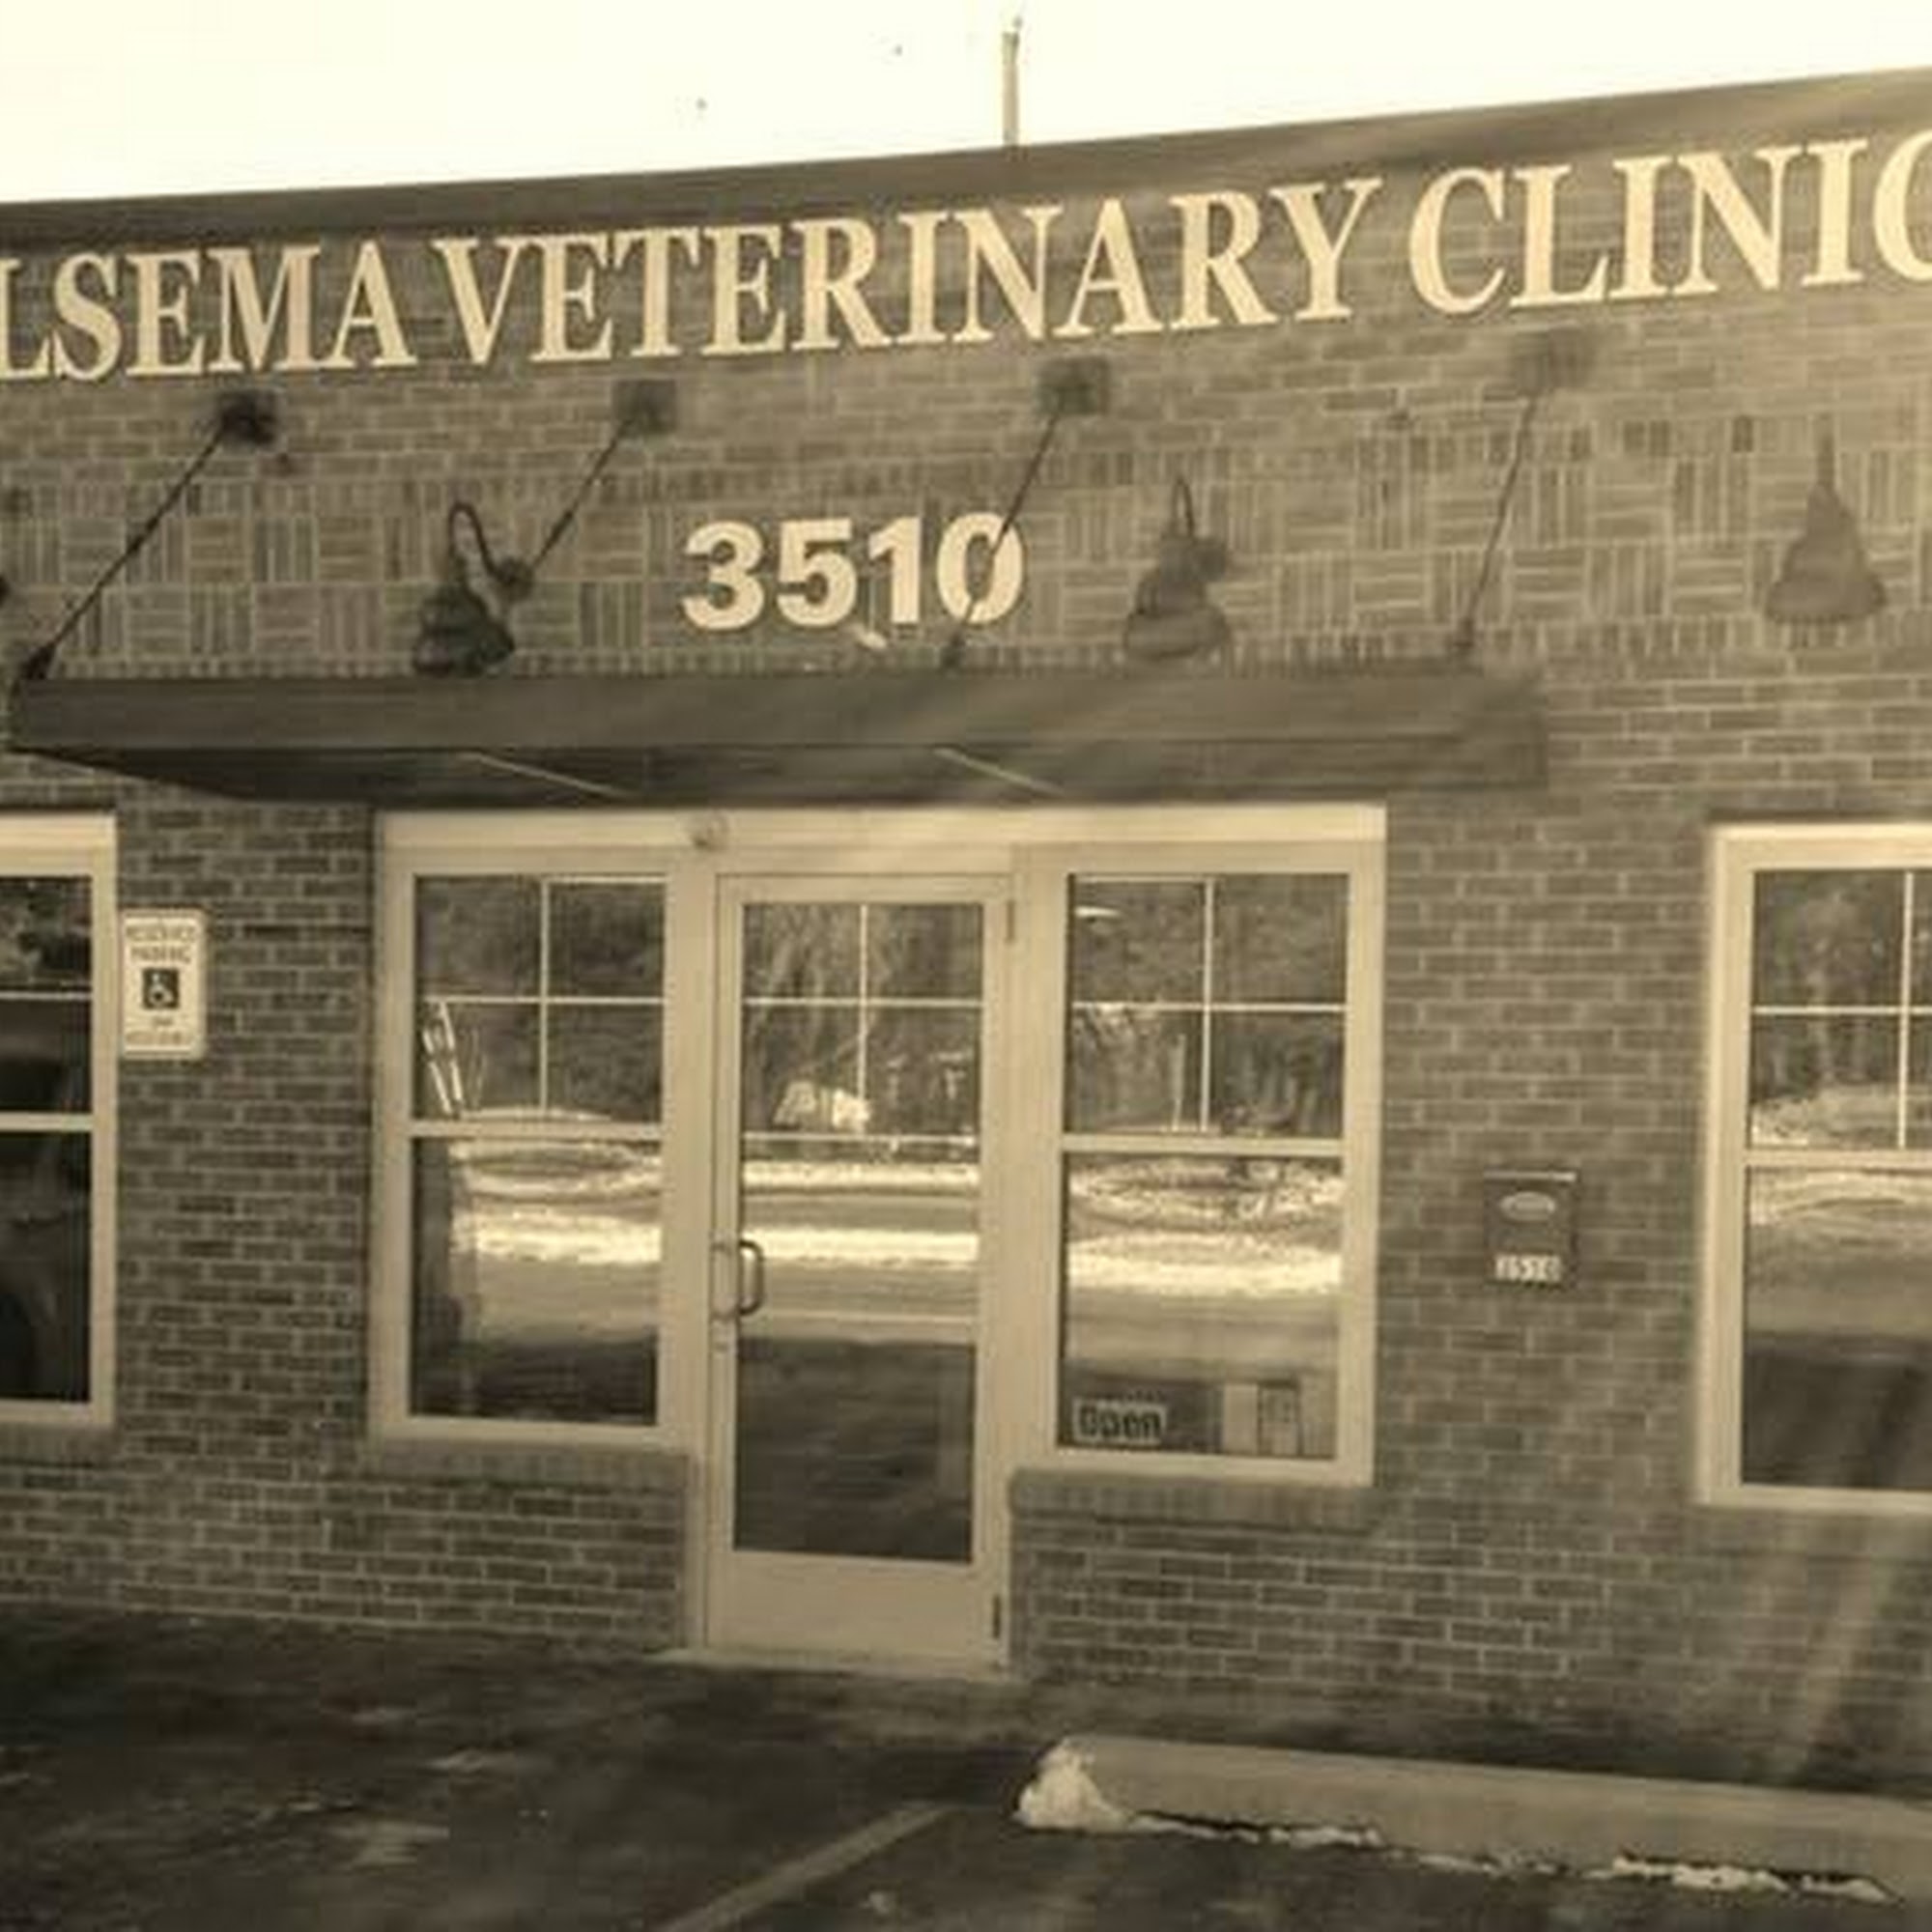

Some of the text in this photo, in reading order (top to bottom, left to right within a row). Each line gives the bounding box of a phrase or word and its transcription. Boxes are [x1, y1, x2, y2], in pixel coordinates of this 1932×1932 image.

[0, 128, 1932, 381] LSEMA VETERINARY CLINIC
[681, 512, 1025, 630] 3510
[1078, 1403, 1161, 1439] Open
